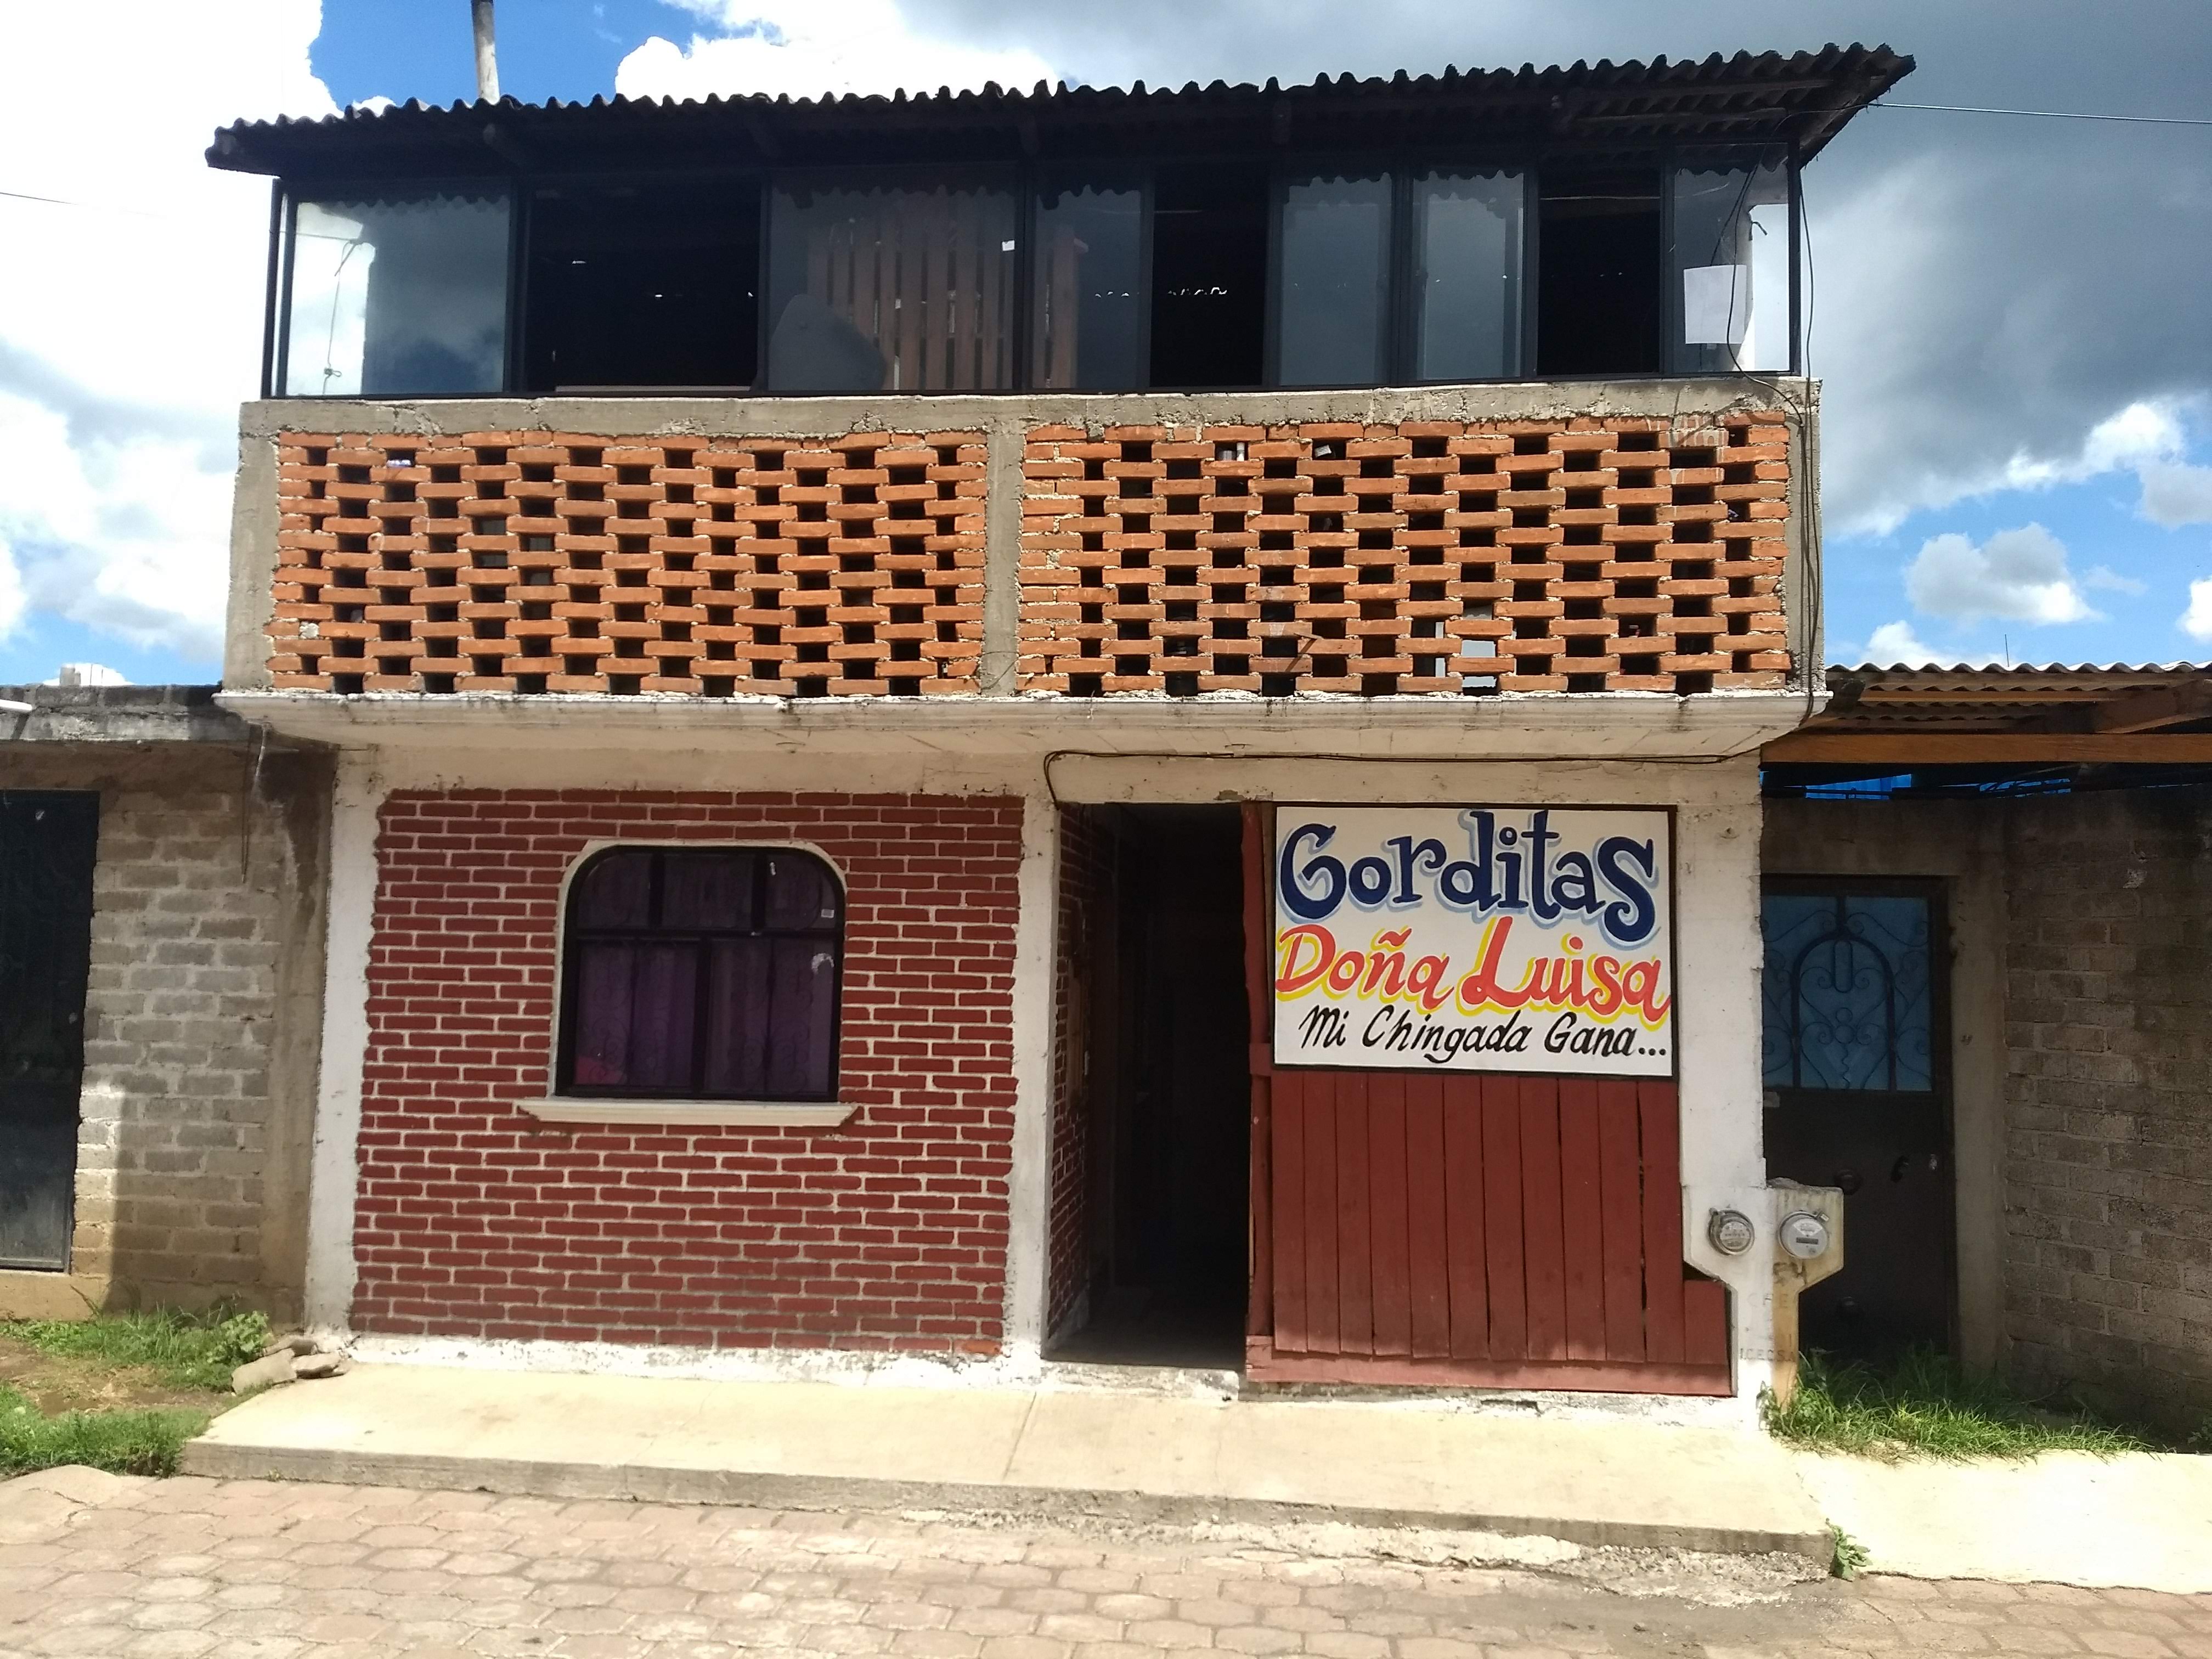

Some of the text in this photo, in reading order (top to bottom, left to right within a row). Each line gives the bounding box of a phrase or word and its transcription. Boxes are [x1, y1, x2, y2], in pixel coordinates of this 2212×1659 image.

[1276, 916, 1672, 1023] Doña Luisa
[1298, 1005, 1667, 1064] Mi Chingada Gana...
